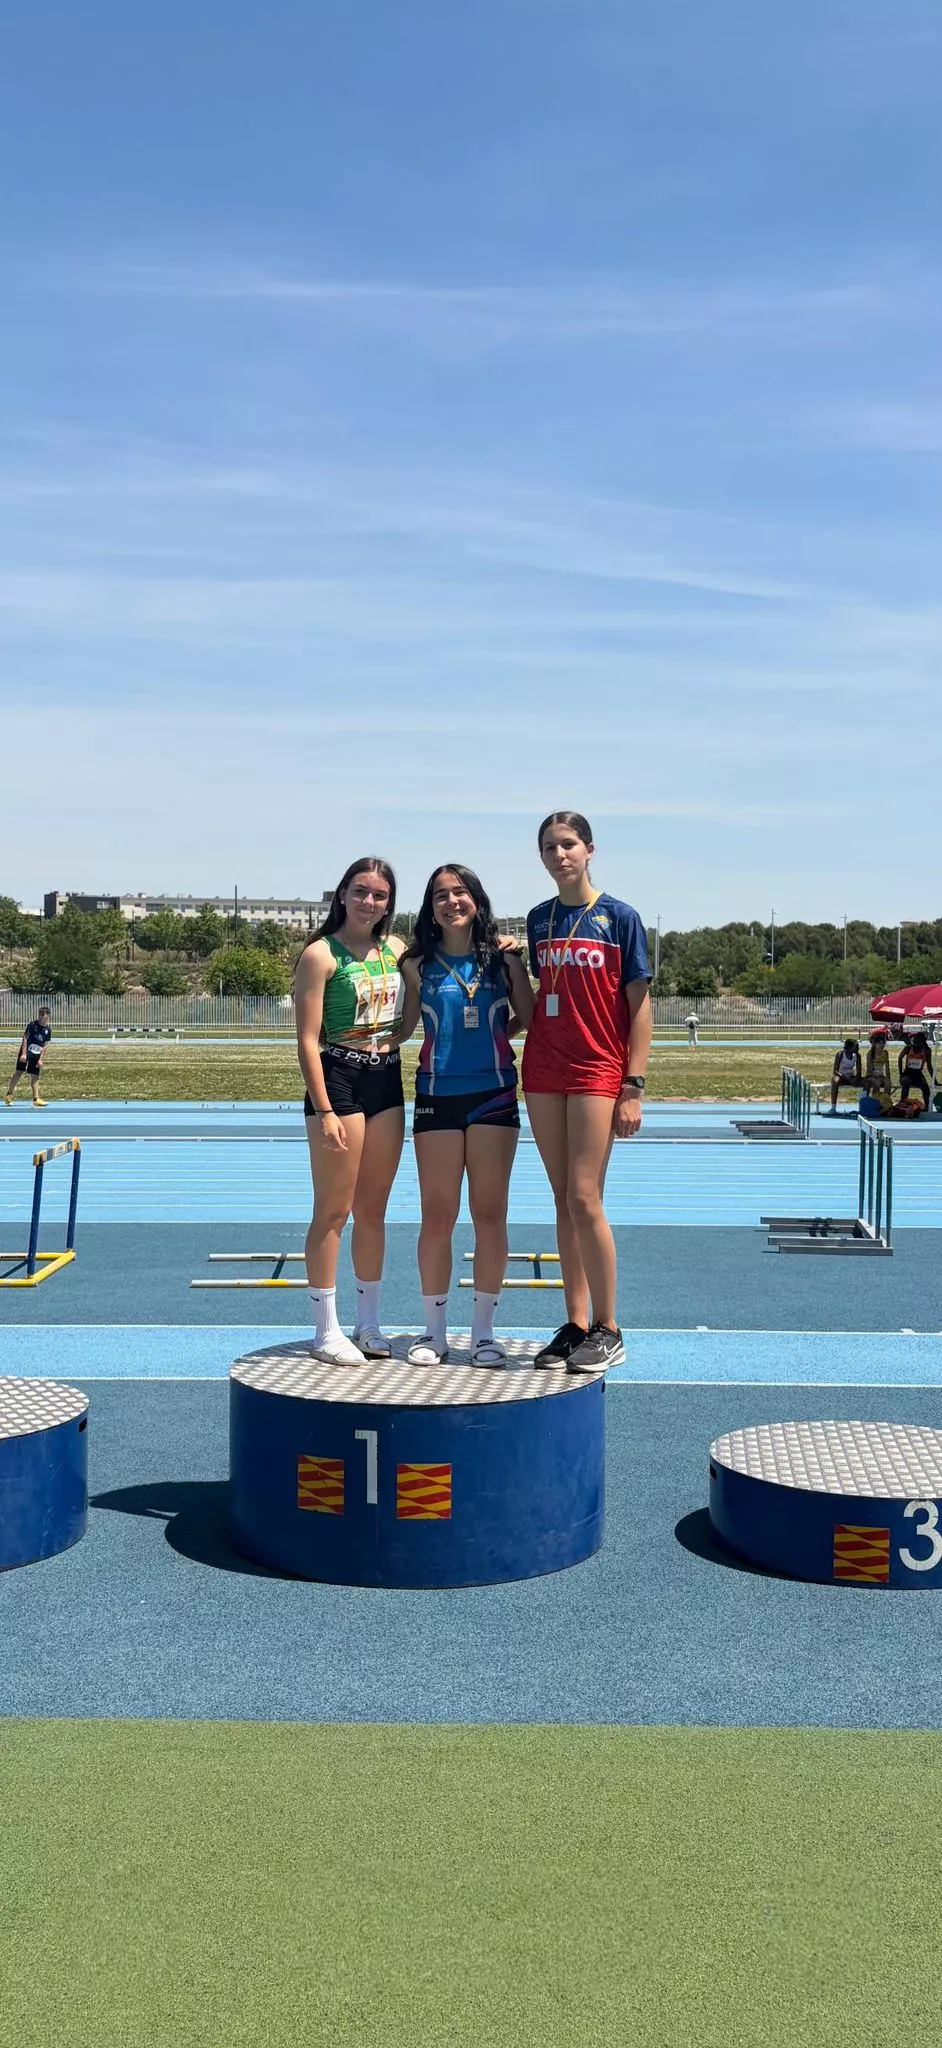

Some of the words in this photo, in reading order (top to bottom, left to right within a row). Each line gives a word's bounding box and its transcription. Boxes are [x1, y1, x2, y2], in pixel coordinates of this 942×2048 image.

[536, 947, 604, 969] SINACO
[345, 1050, 380, 1065] PRO
[355, 1430, 377, 1504] 1
[899, 1500, 942, 1571] 3
